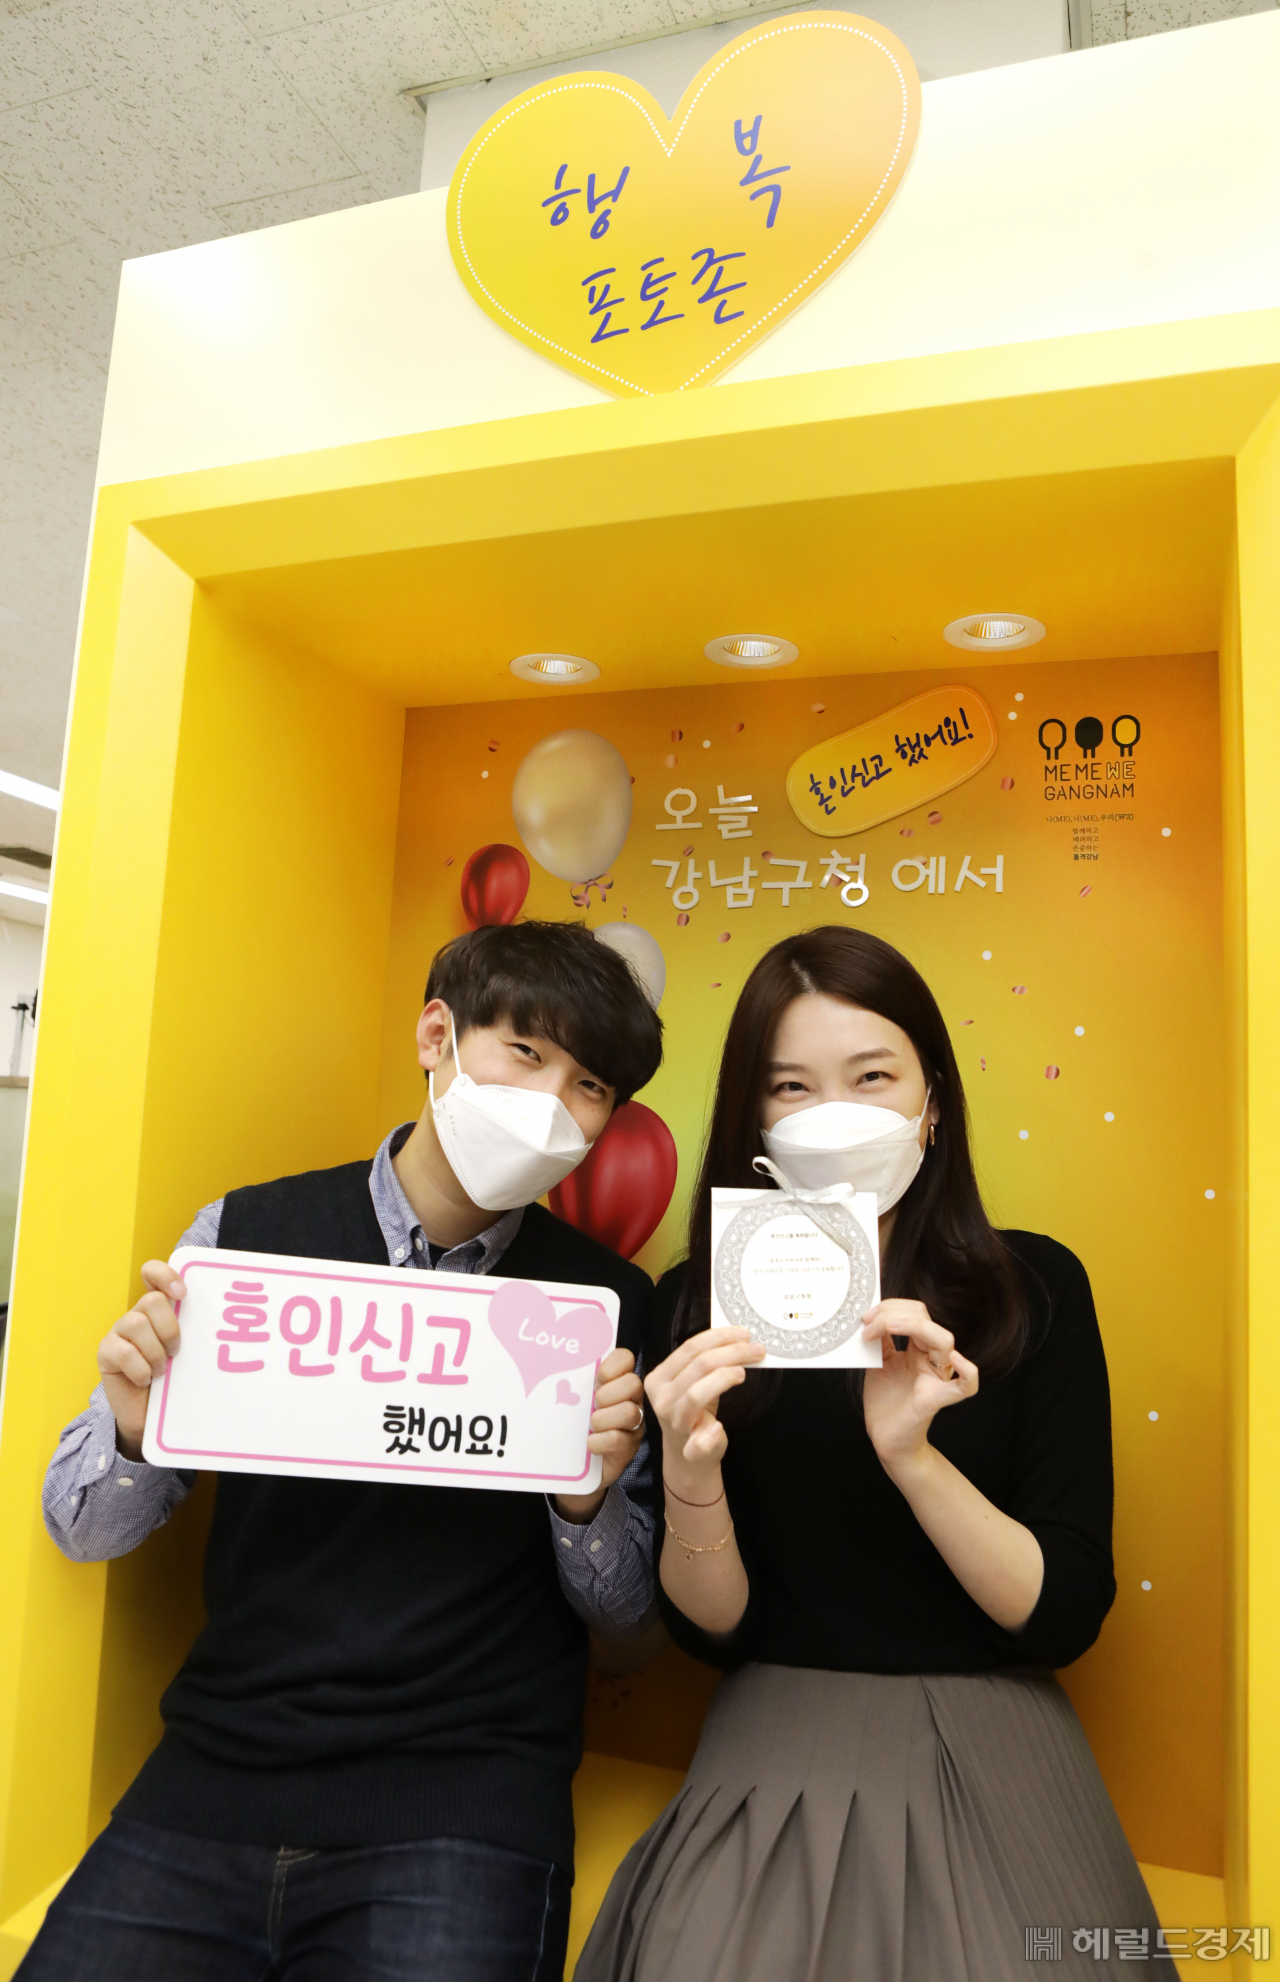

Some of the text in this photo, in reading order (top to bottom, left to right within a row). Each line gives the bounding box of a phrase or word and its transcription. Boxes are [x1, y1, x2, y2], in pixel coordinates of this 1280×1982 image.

[581, 247, 748, 344] 포토존
[808, 707, 974, 816] 혼인신고 했어요!
[655, 784, 759, 840] 오늘
[1044, 783, 1135, 801] GANGNAM
[651, 849, 1004, 911] 강남구청 에서
[215, 1280, 472, 1386] 혼인신고
[517, 1318, 580, 1355] Love
[382, 1404, 508, 1458] 했어요!
